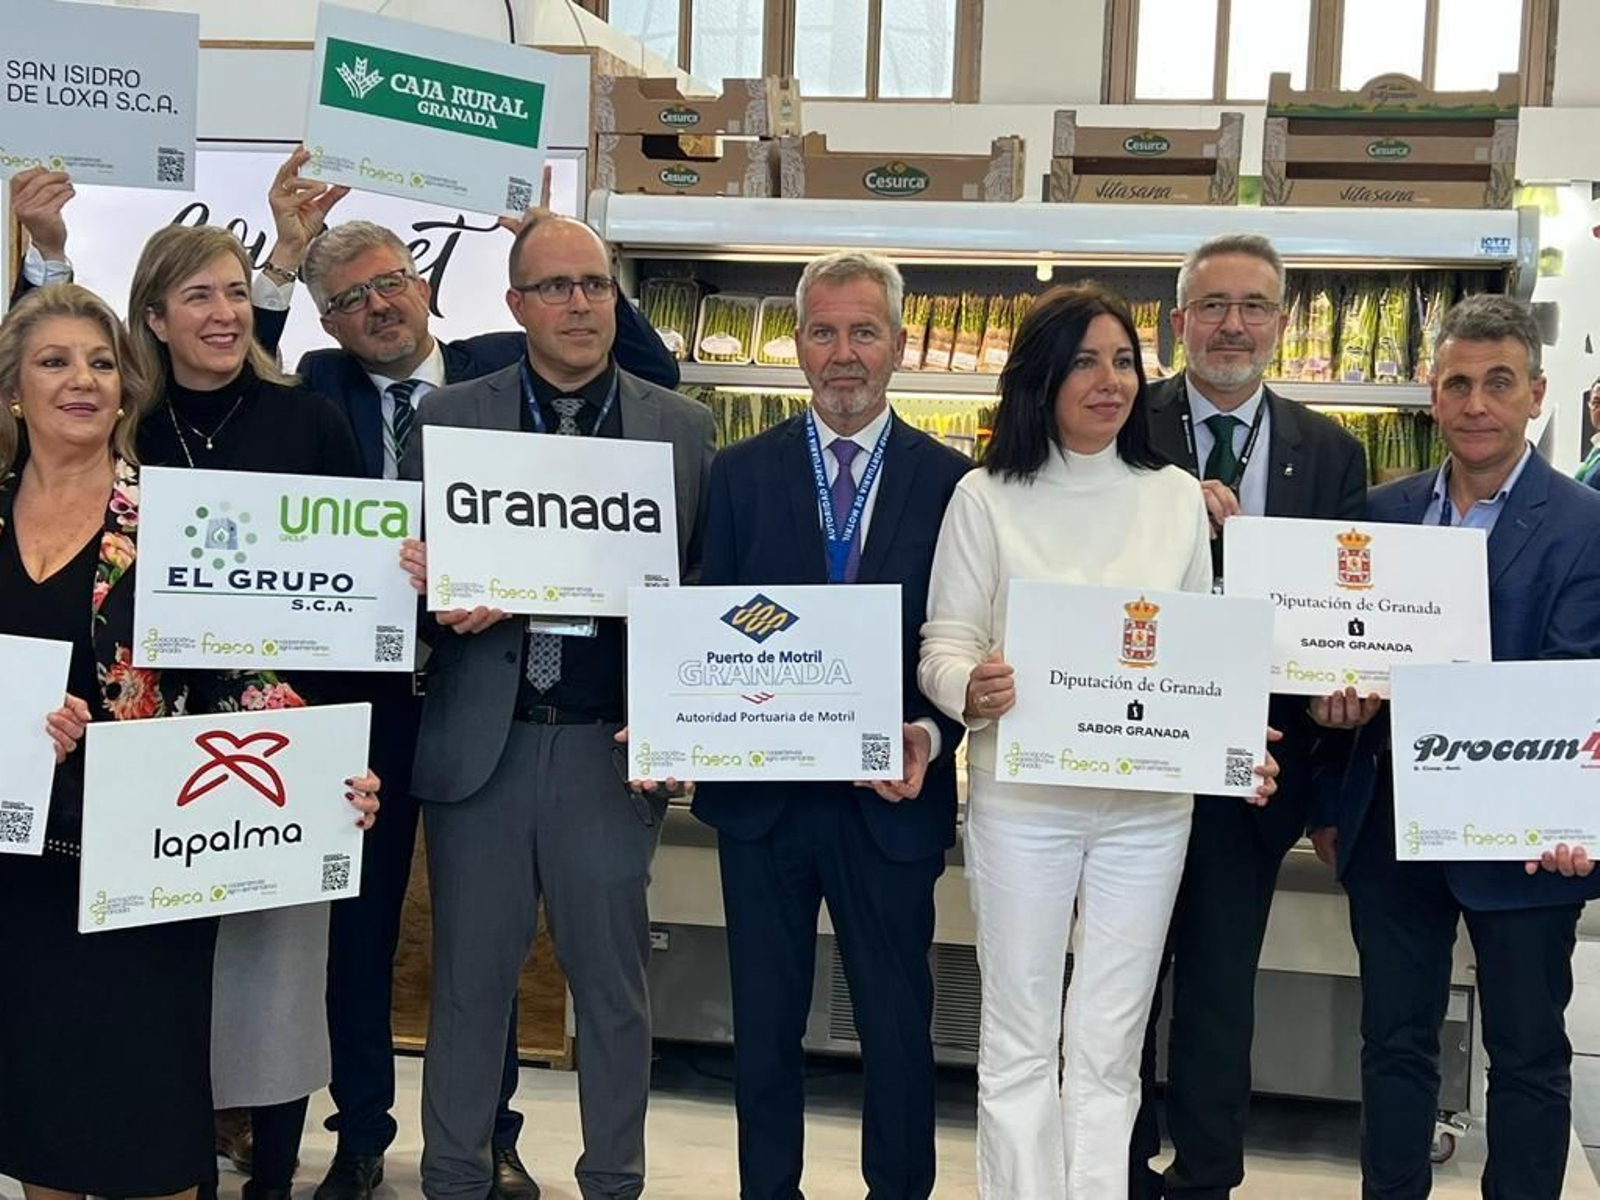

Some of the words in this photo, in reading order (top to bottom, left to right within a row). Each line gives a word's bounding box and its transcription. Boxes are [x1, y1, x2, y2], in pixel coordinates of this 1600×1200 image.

[6, 59, 56, 82] SAN
[64, 64, 141, 89] ISIDRO
[7, 83, 38, 104] DE
[47, 87, 108, 109] LOXA
[115, 91, 178, 115] S.C.A.
[390, 73, 446, 101] CAJA
[451, 84, 528, 119] RURAL
[417, 100, 498, 129] GRANADA
[660, 110, 699, 124] Cesurca
[1125, 139, 1168, 151] Cesurca
[359, 156, 404, 185] faeca
[660, 170, 698, 184] Cesurca
[864, 172, 926, 190] Cesurca
[809, 438, 826, 487] PORTUARIA
[860, 446, 885, 495] PORTUARIA
[446, 482, 662, 534] Granada
[853, 495, 866, 508] DE
[819, 488, 837, 541] AUTORIDAD
[841, 509, 861, 541] MOTRIL
[167, 566, 214, 588] EL
[227, 569, 354, 593] GRUPO
[489, 577, 538, 600] faeca
[291, 599, 354, 613] S.C.A.
[1356, 598, 1374, 611] de
[1378, 599, 1442, 615] Granada
[200, 632, 255, 655] faeca
[1301, 638, 1345, 650] SABOR
[1348, 641, 1414, 653] GRANADA
[706, 650, 754, 664] Puerto
[757, 651, 776, 664] de
[779, 649, 823, 664] Motril
[678, 658, 852, 687] GRANADA
[1286, 661, 1336, 683] faeca
[1049, 670, 1133, 691] Diputación
[1137, 676, 1155, 691] de
[1160, 679, 1223, 698] Granada
[676, 711, 737, 723] Autoridad
[740, 711, 796, 723] Portuaria
[799, 711, 815, 723] de
[818, 711, 856, 723] Motril
[1077, 722, 1123, 735] SABOR
[1126, 726, 1190, 741] GRANADA
[690, 744, 743, 767] faeca
[1413, 733, 1580, 762] Procam
[1060, 748, 1110, 773] faeca
[153, 819, 302, 868] lapalma
[1462, 823, 1518, 846] faeca
[150, 886, 204, 909] faeca
